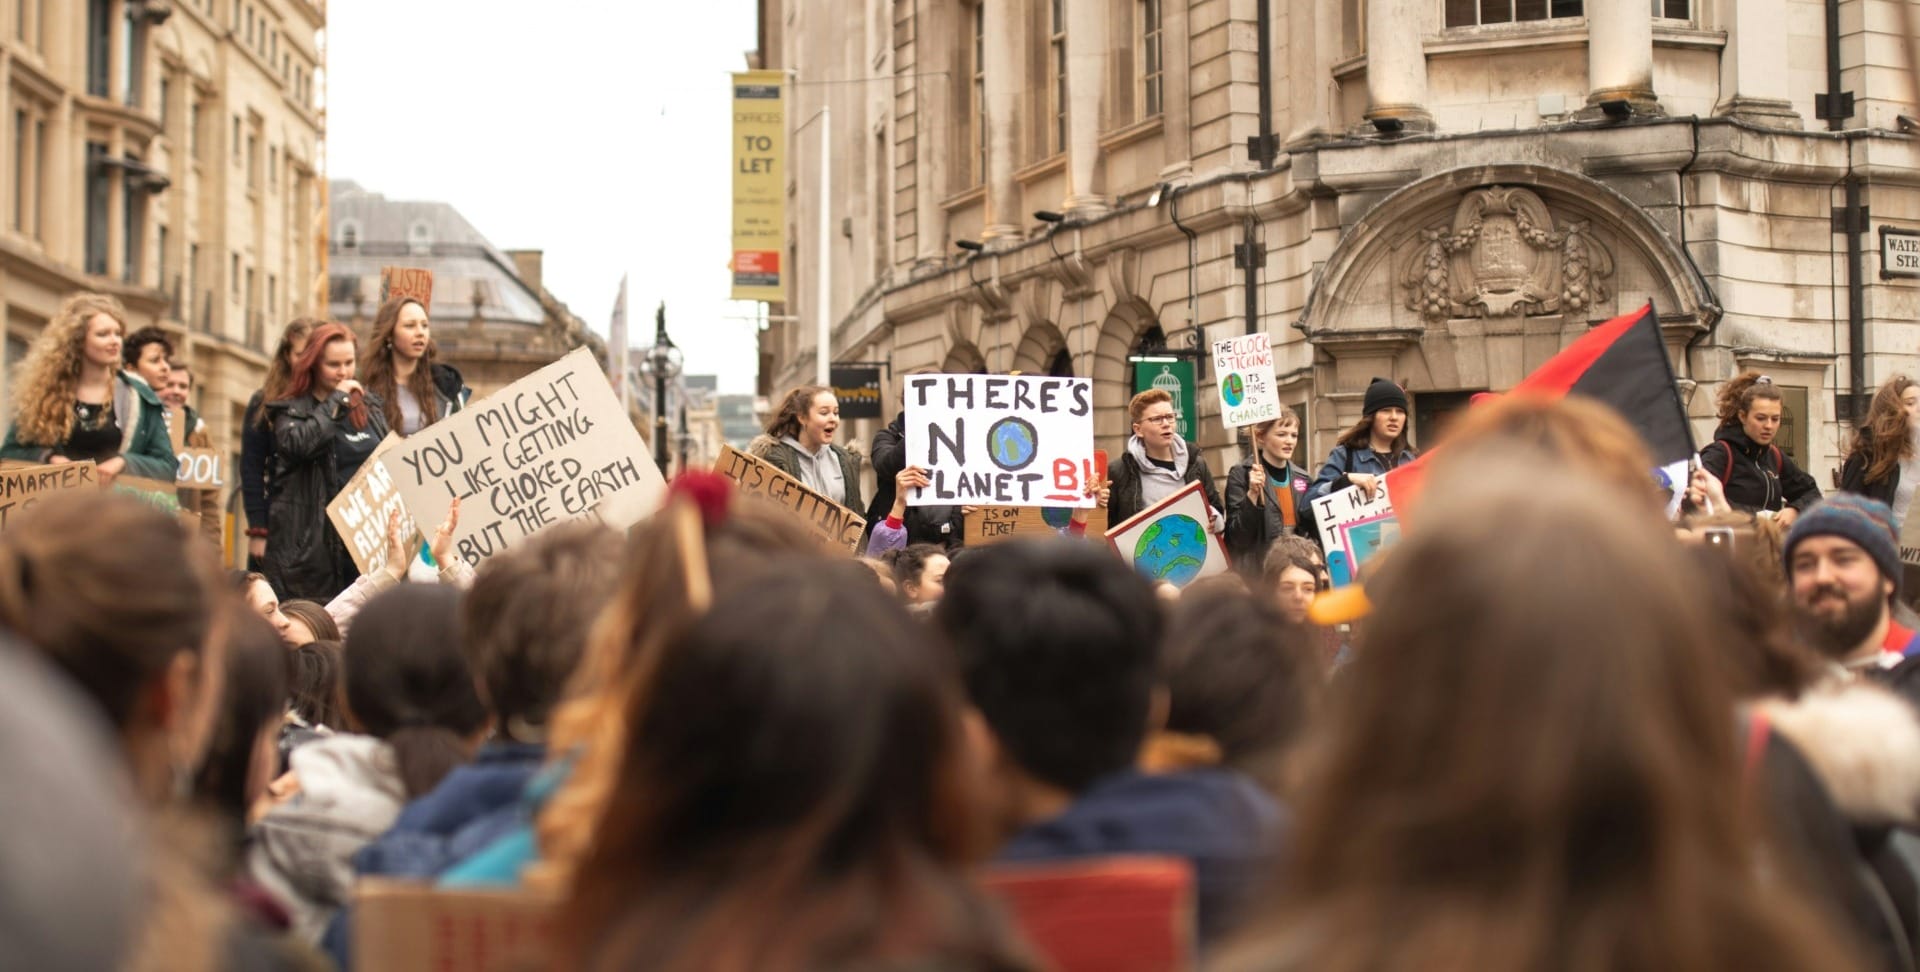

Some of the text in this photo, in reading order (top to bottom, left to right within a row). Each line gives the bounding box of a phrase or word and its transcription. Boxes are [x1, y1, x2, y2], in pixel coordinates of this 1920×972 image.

[743, 135, 772, 152] TO
[740, 157, 775, 175] LET
[1896, 254, 1919, 268] STR
[1214, 335, 1270, 356] THE CLOCK
[1217, 353, 1271, 370] IS TICKING
[911, 377, 1090, 417] THERE'S
[1246, 382, 1266, 394] TIME
[1247, 397, 1258, 405] TO
[1229, 403, 1273, 423] CHANGE
[402, 371, 579, 486] YOU MIGHT
[444, 407, 594, 501] LIKE GETTING
[338, 459, 394, 529] WE AR
[490, 457, 582, 517] CHOKED
[724, 450, 765, 489] IT'S
[767, 474, 862, 546] GETTING
[1319, 479, 1386, 522] I WIS
[457, 520, 508, 568] BUT
[509, 497, 557, 537] THE
[560, 456, 641, 515] EARTH
[984, 507, 1019, 521] IS ON
[982, 520, 1016, 537] FIRE!
